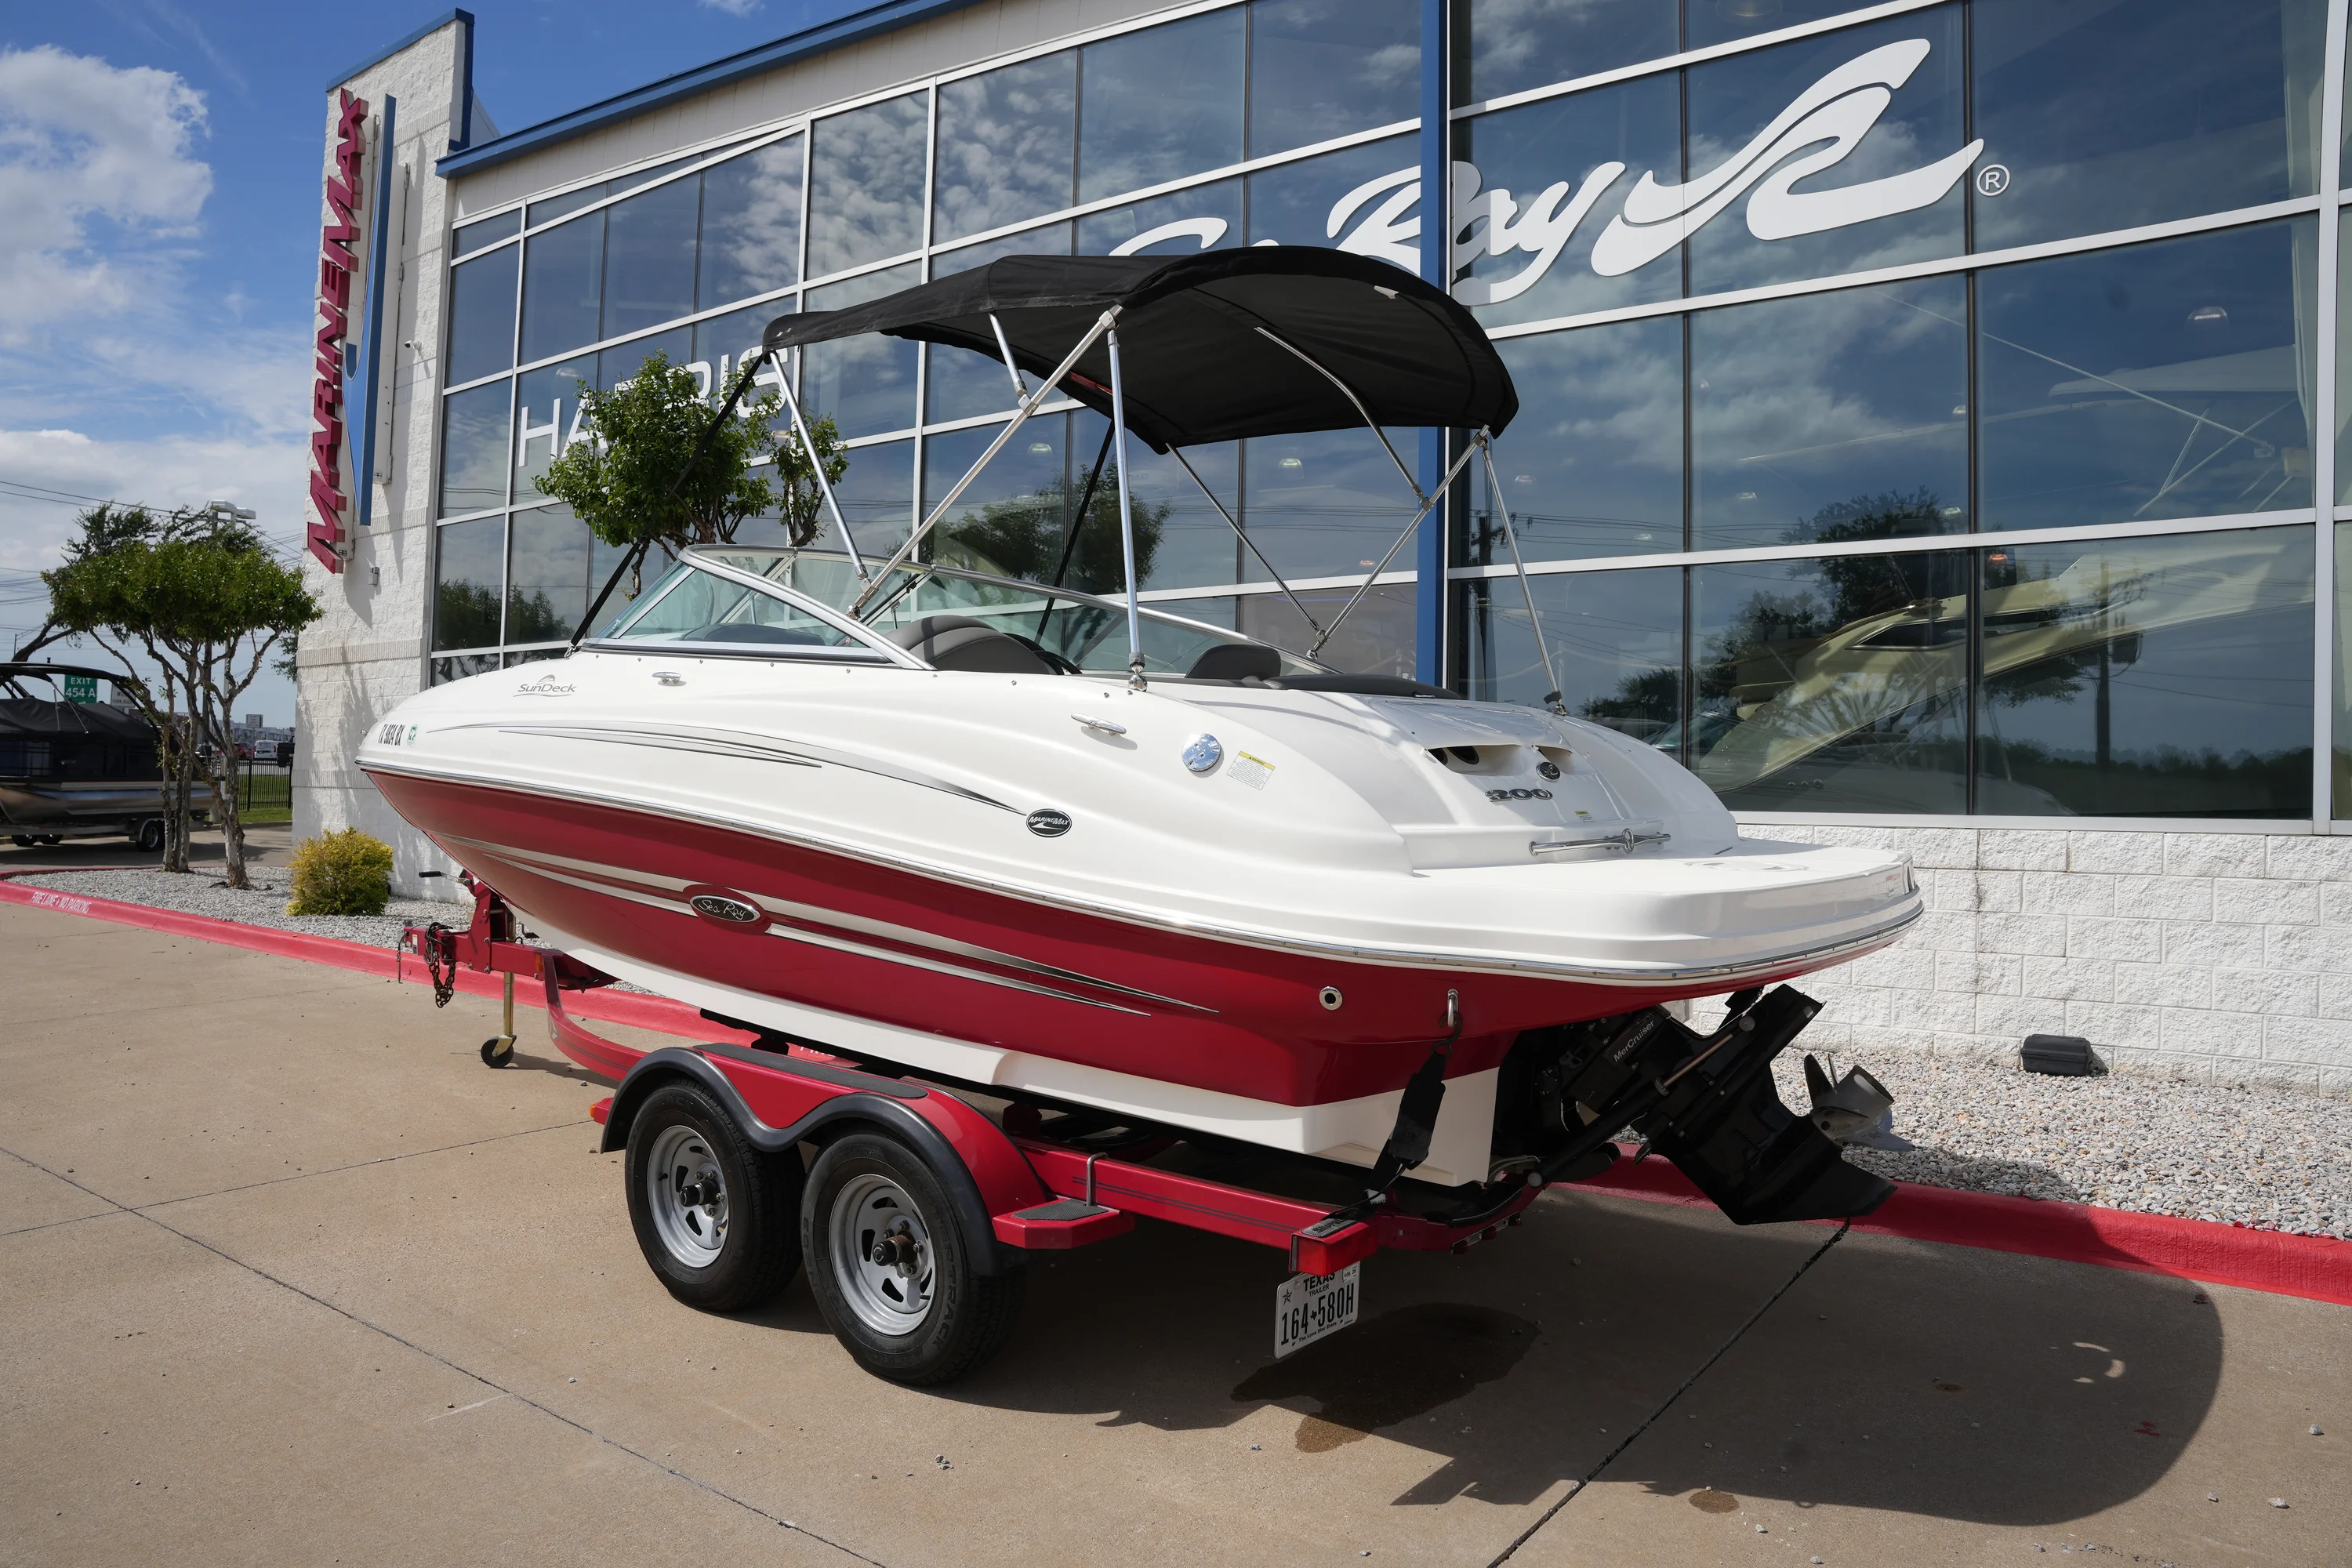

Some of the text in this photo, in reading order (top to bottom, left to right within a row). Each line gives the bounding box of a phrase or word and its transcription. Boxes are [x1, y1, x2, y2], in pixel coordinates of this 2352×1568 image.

[65, 688, 96, 697] 454 A
[517, 684, 577, 692] SunDeck
[1485, 789, 1553, 802] 200
[31, 891, 92, 914] FIRE LANE NO PARKING
[698, 899, 747, 920] Sea Ray
[1613, 1019, 1655, 1062] MerCruiser
[1308, 1284, 1330, 1297] TRAILER
[1281, 1283, 1355, 1345] 164 580H
[1327, 1321, 1337, 1330] State
